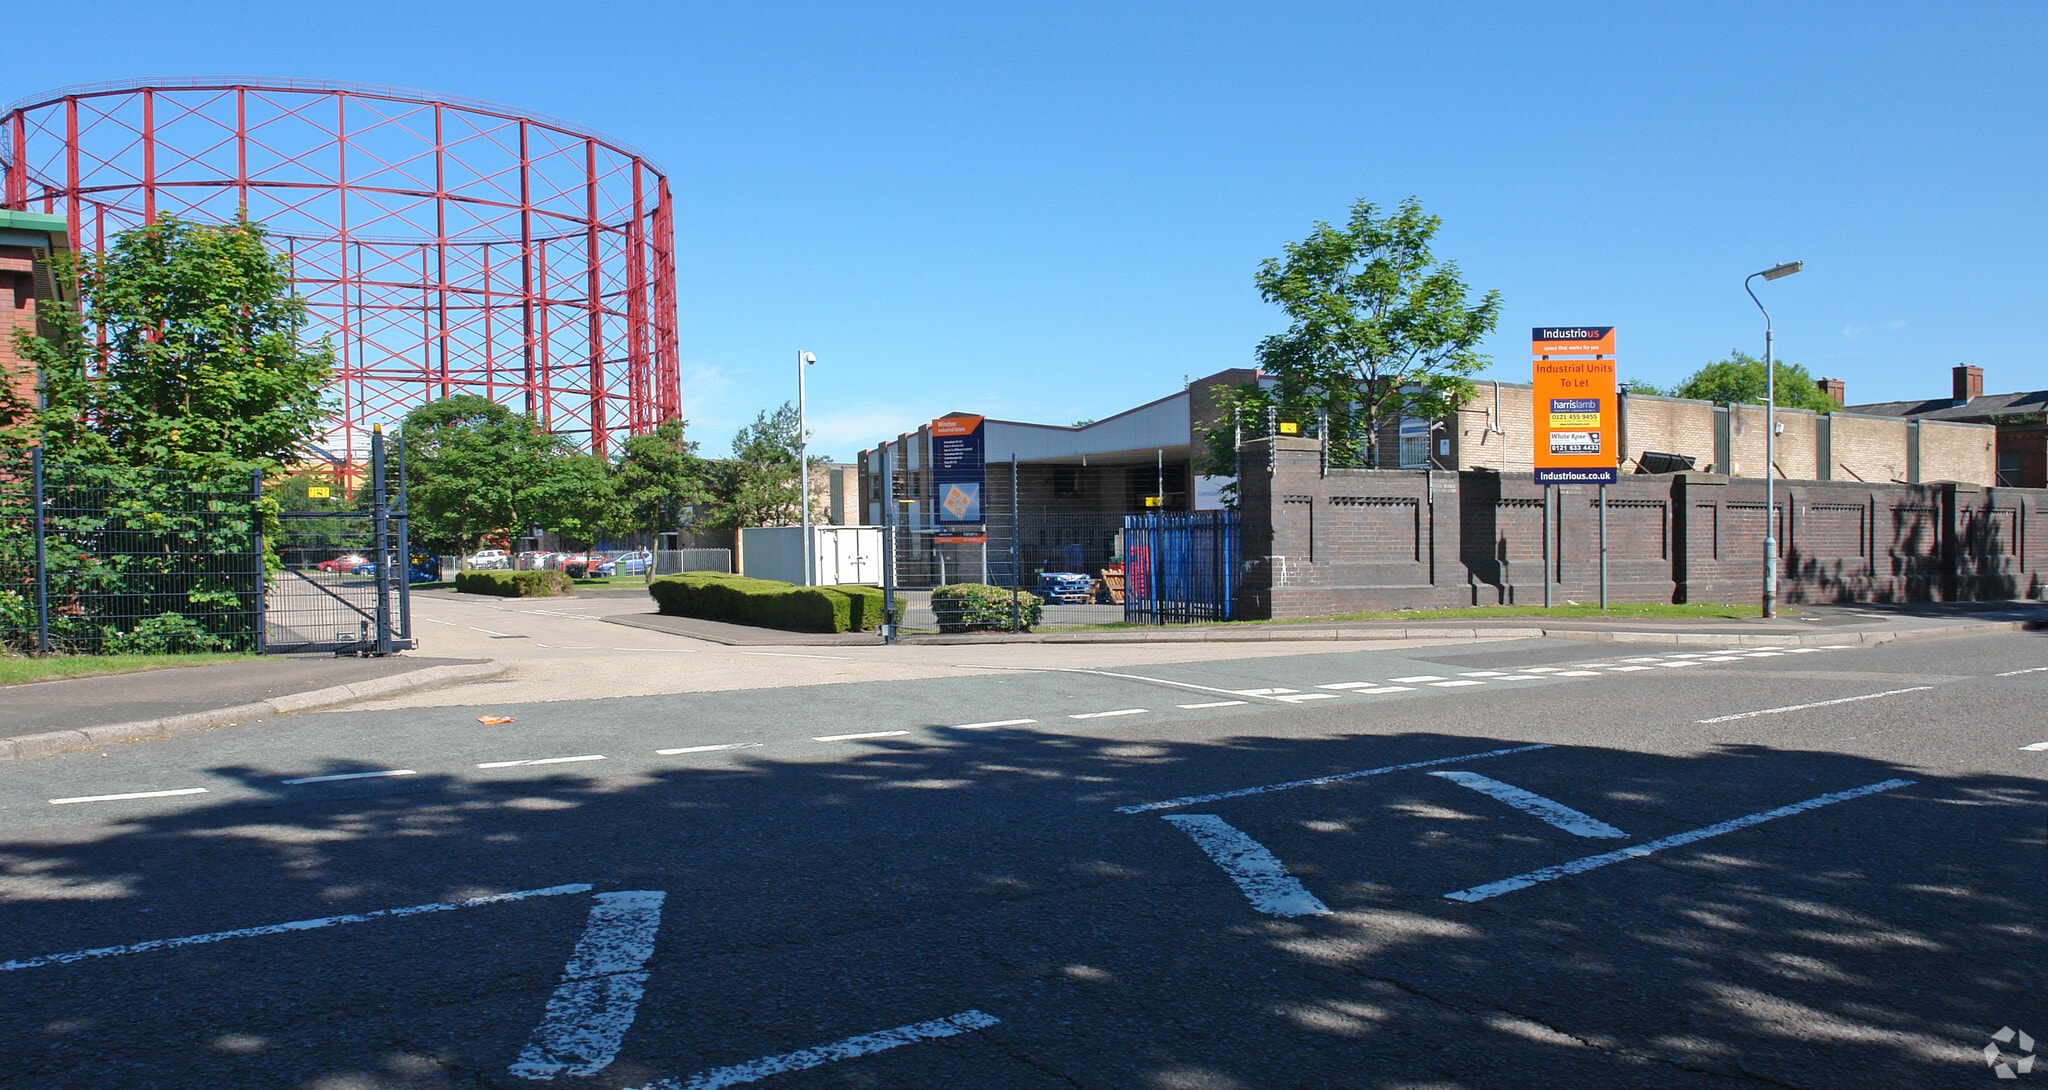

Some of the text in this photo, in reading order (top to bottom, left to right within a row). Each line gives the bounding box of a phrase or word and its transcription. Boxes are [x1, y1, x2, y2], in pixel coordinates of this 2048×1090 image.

[1543, 329, 1600, 338] Industrious
[1536, 364, 1613, 373] Industrial Units
[1560, 379, 1589, 387] To Let
[1553, 400, 1596, 409] harrislamb
